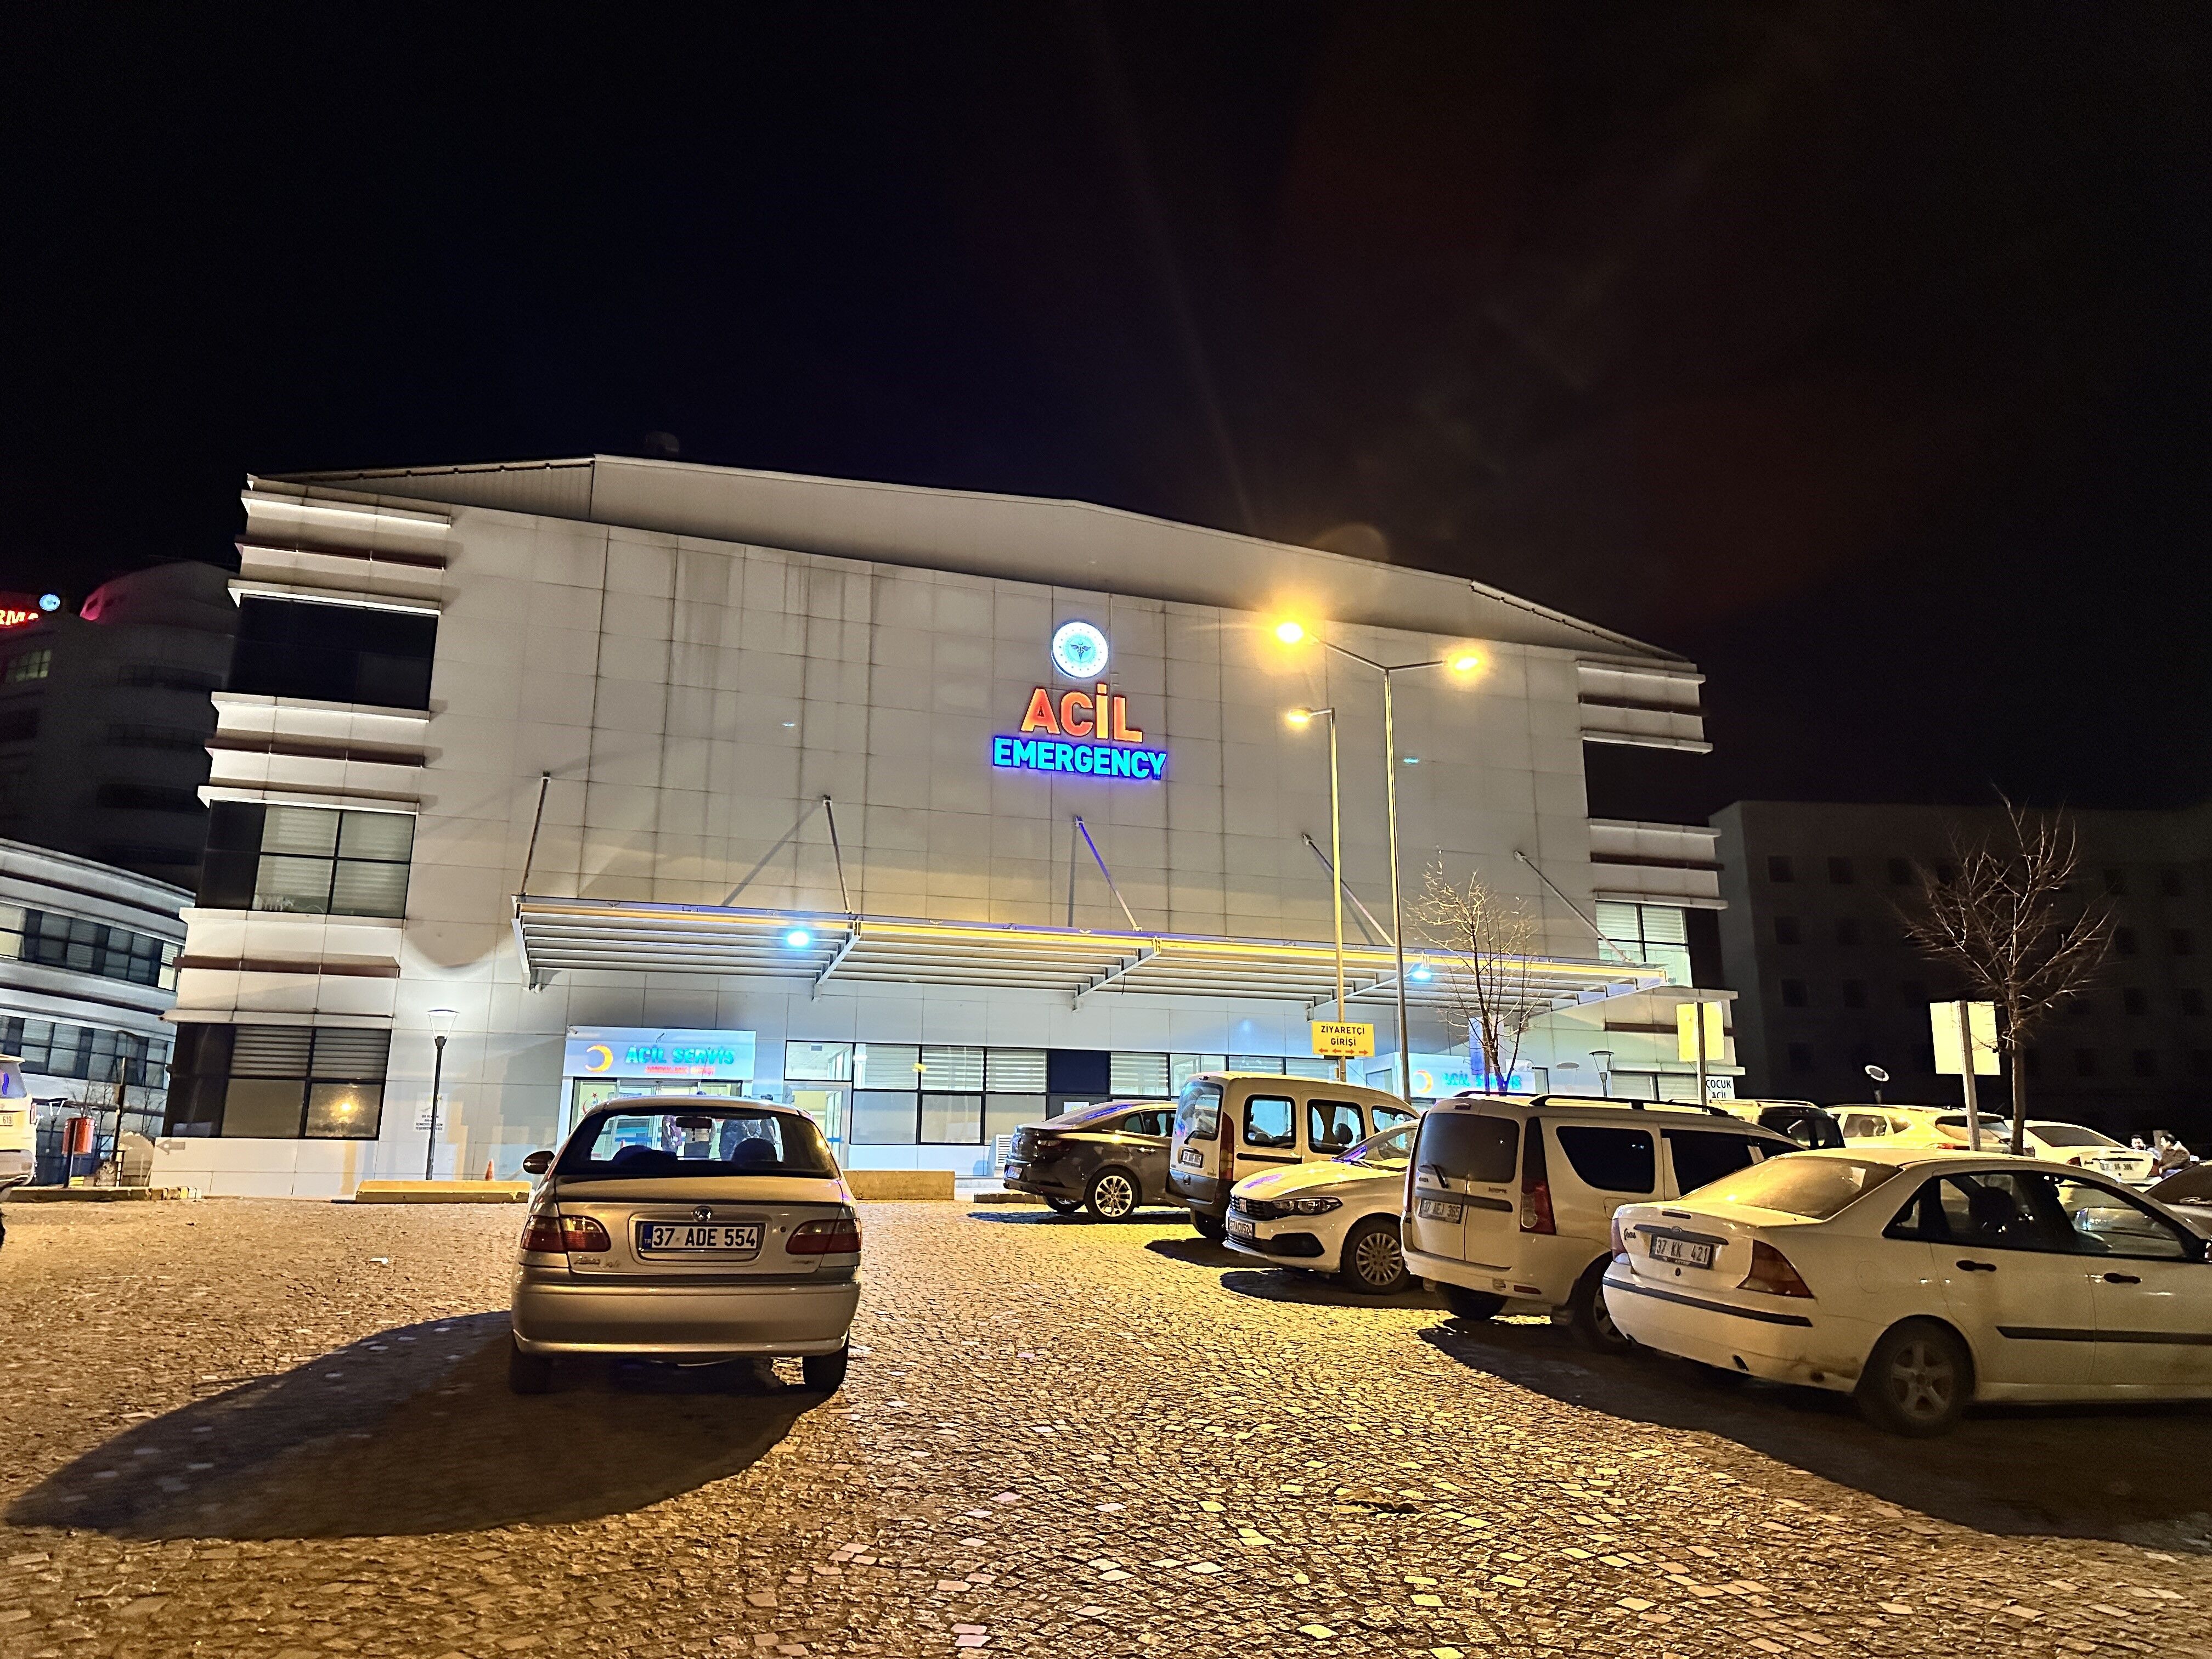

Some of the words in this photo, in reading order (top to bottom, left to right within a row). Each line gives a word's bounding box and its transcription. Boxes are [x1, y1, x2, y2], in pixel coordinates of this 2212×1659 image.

[1020, 683, 1143, 743] ACİL
[994, 737, 1167, 780] EMERGENCY
[1321, 1024, 1365, 1035] ZİYARETÇİ
[1331, 1036, 1356, 1047] GİRİŞİ
[625, 1045, 667, 1063] ACİL
[1706, 1079, 1731, 1090] ÇOCUK
[653, 1228, 675, 1246] 37
[685, 1228, 717, 1246] ADE
[724, 1228, 755, 1246] 554
[1657, 1239, 1667, 1254] 37
[1691, 1245, 1708, 1263] 421
